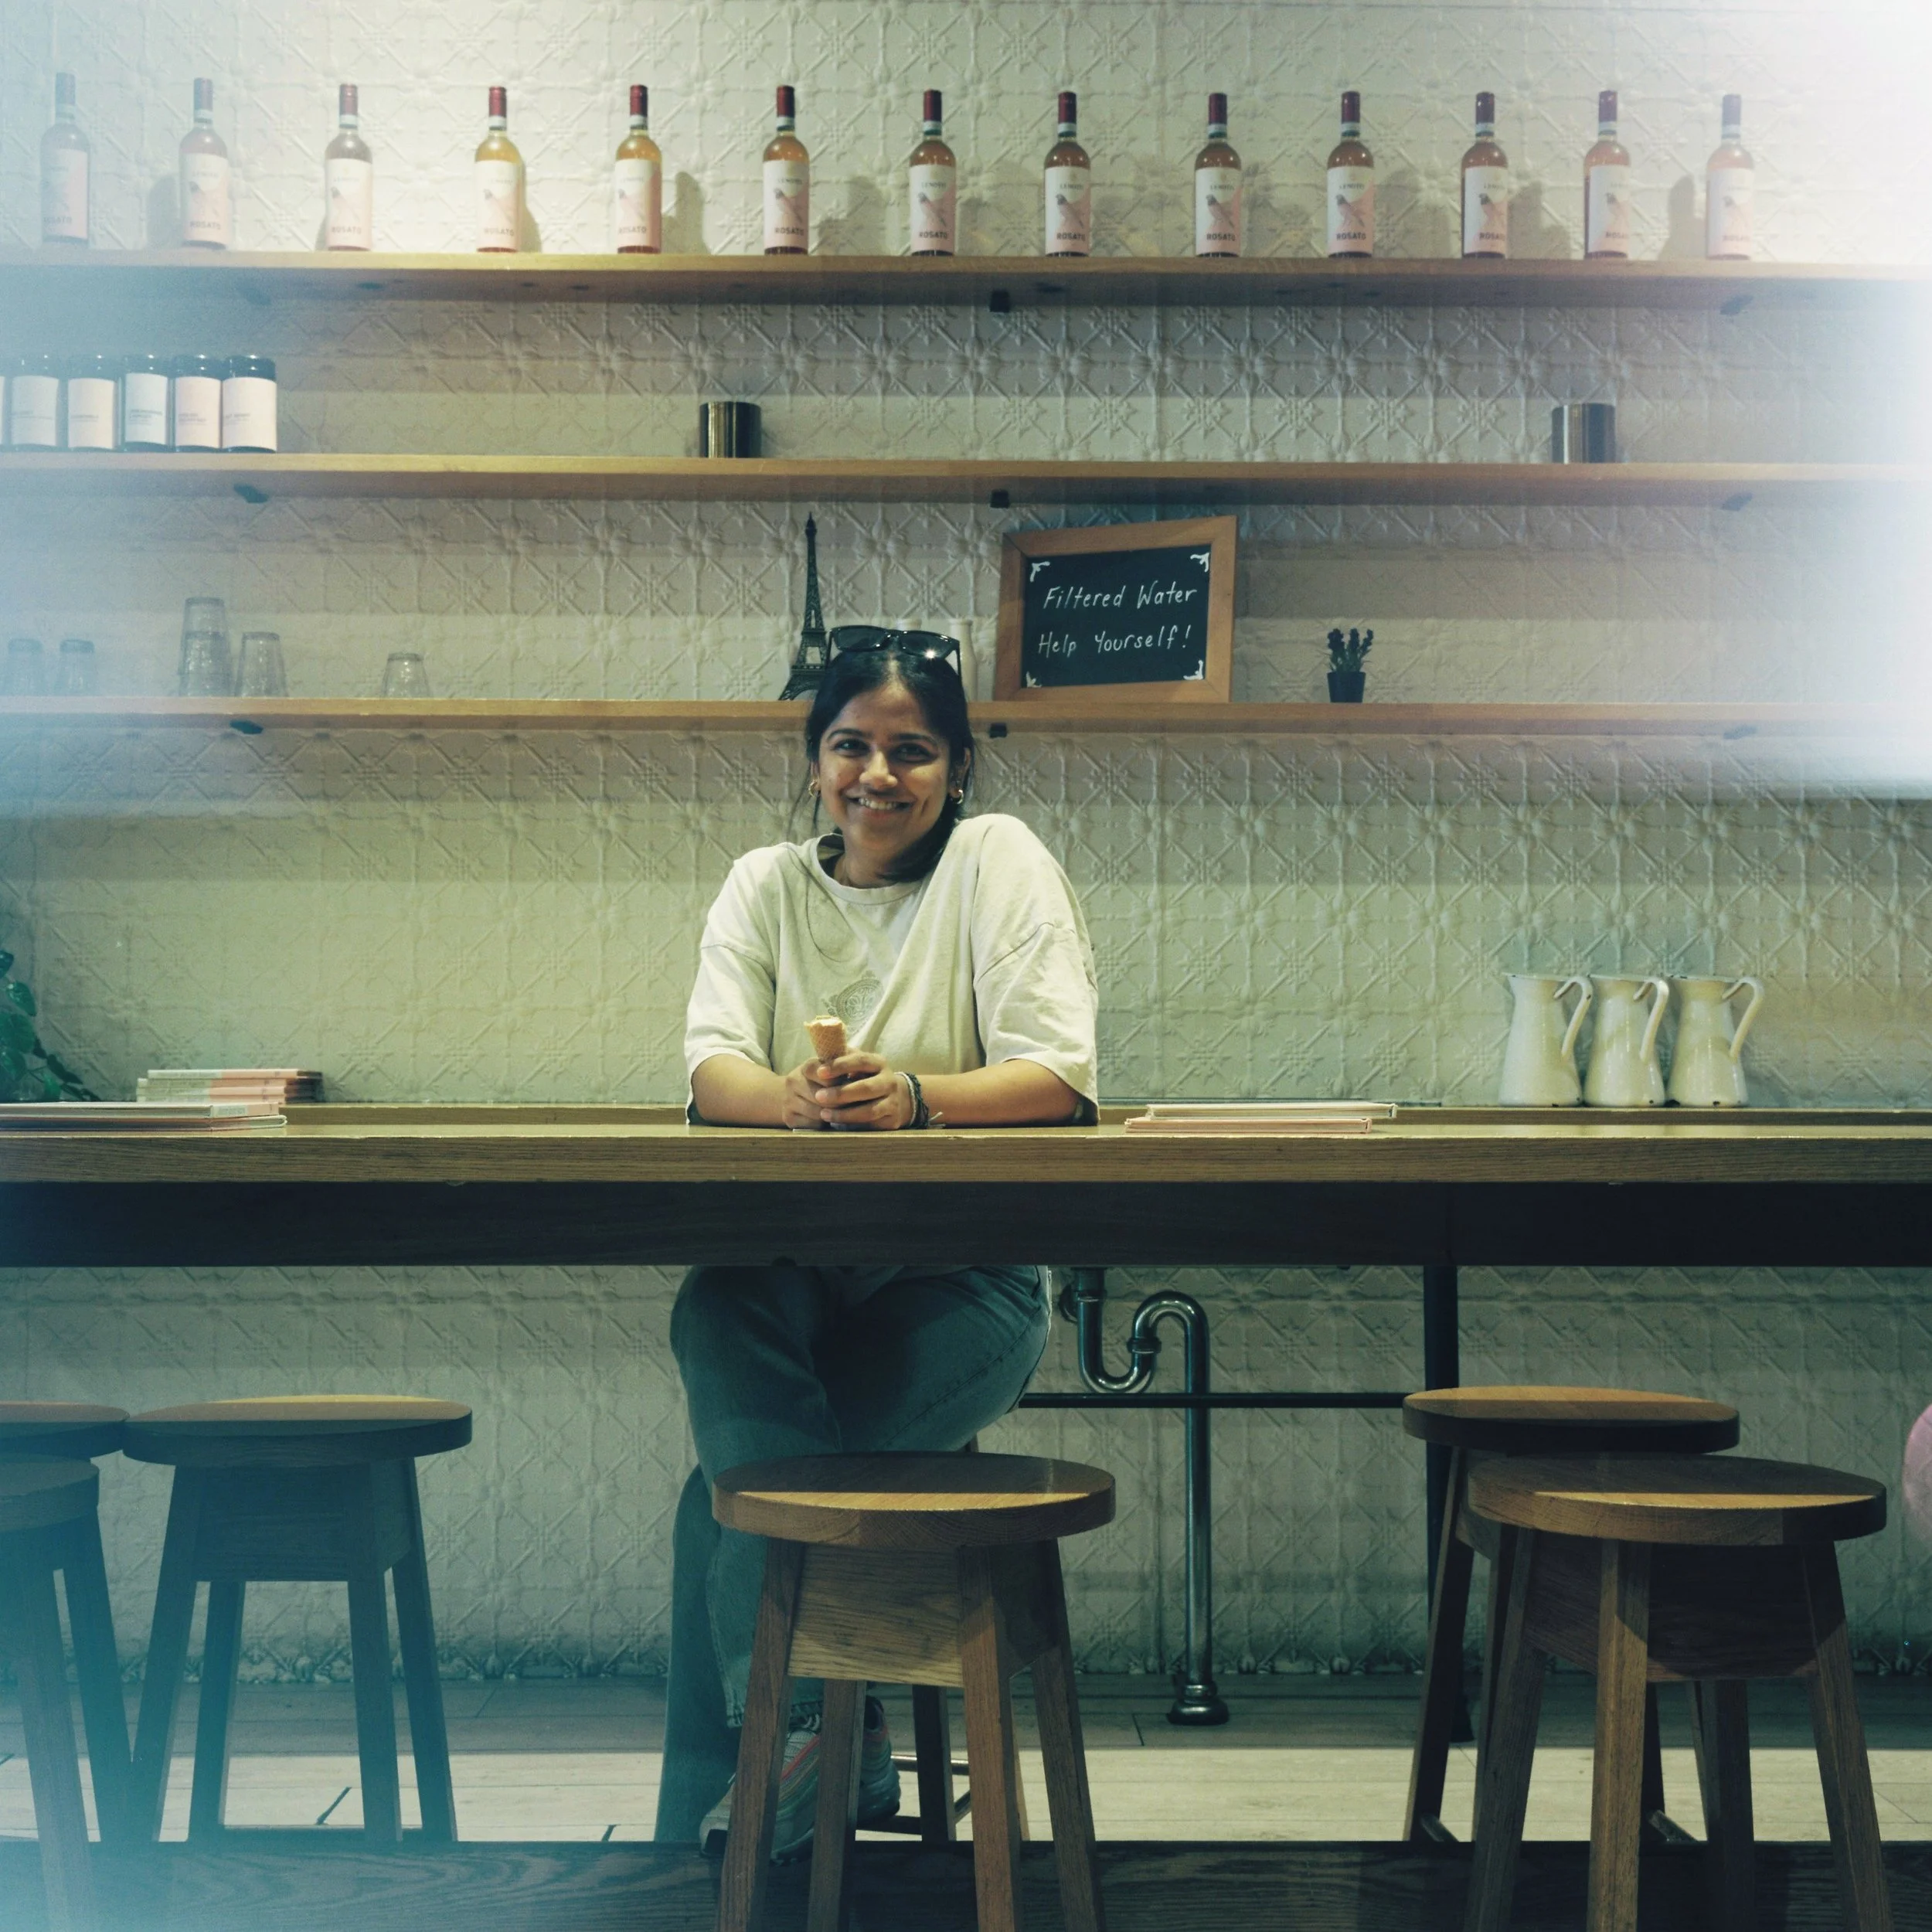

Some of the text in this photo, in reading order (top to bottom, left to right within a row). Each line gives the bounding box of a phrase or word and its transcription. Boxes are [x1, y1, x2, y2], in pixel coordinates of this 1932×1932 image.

[189, 221, 220, 230] ROSATO
[775, 227, 804, 236] ROSATO
[919, 231, 948, 240] ROSATO
[1336, 232, 1366, 240] ROSATO
[1056, 232, 1086, 241] ROSATO
[1043, 580, 1197, 609] Filtered Water
[1039, 624, 1191, 658] Help Yourself!
